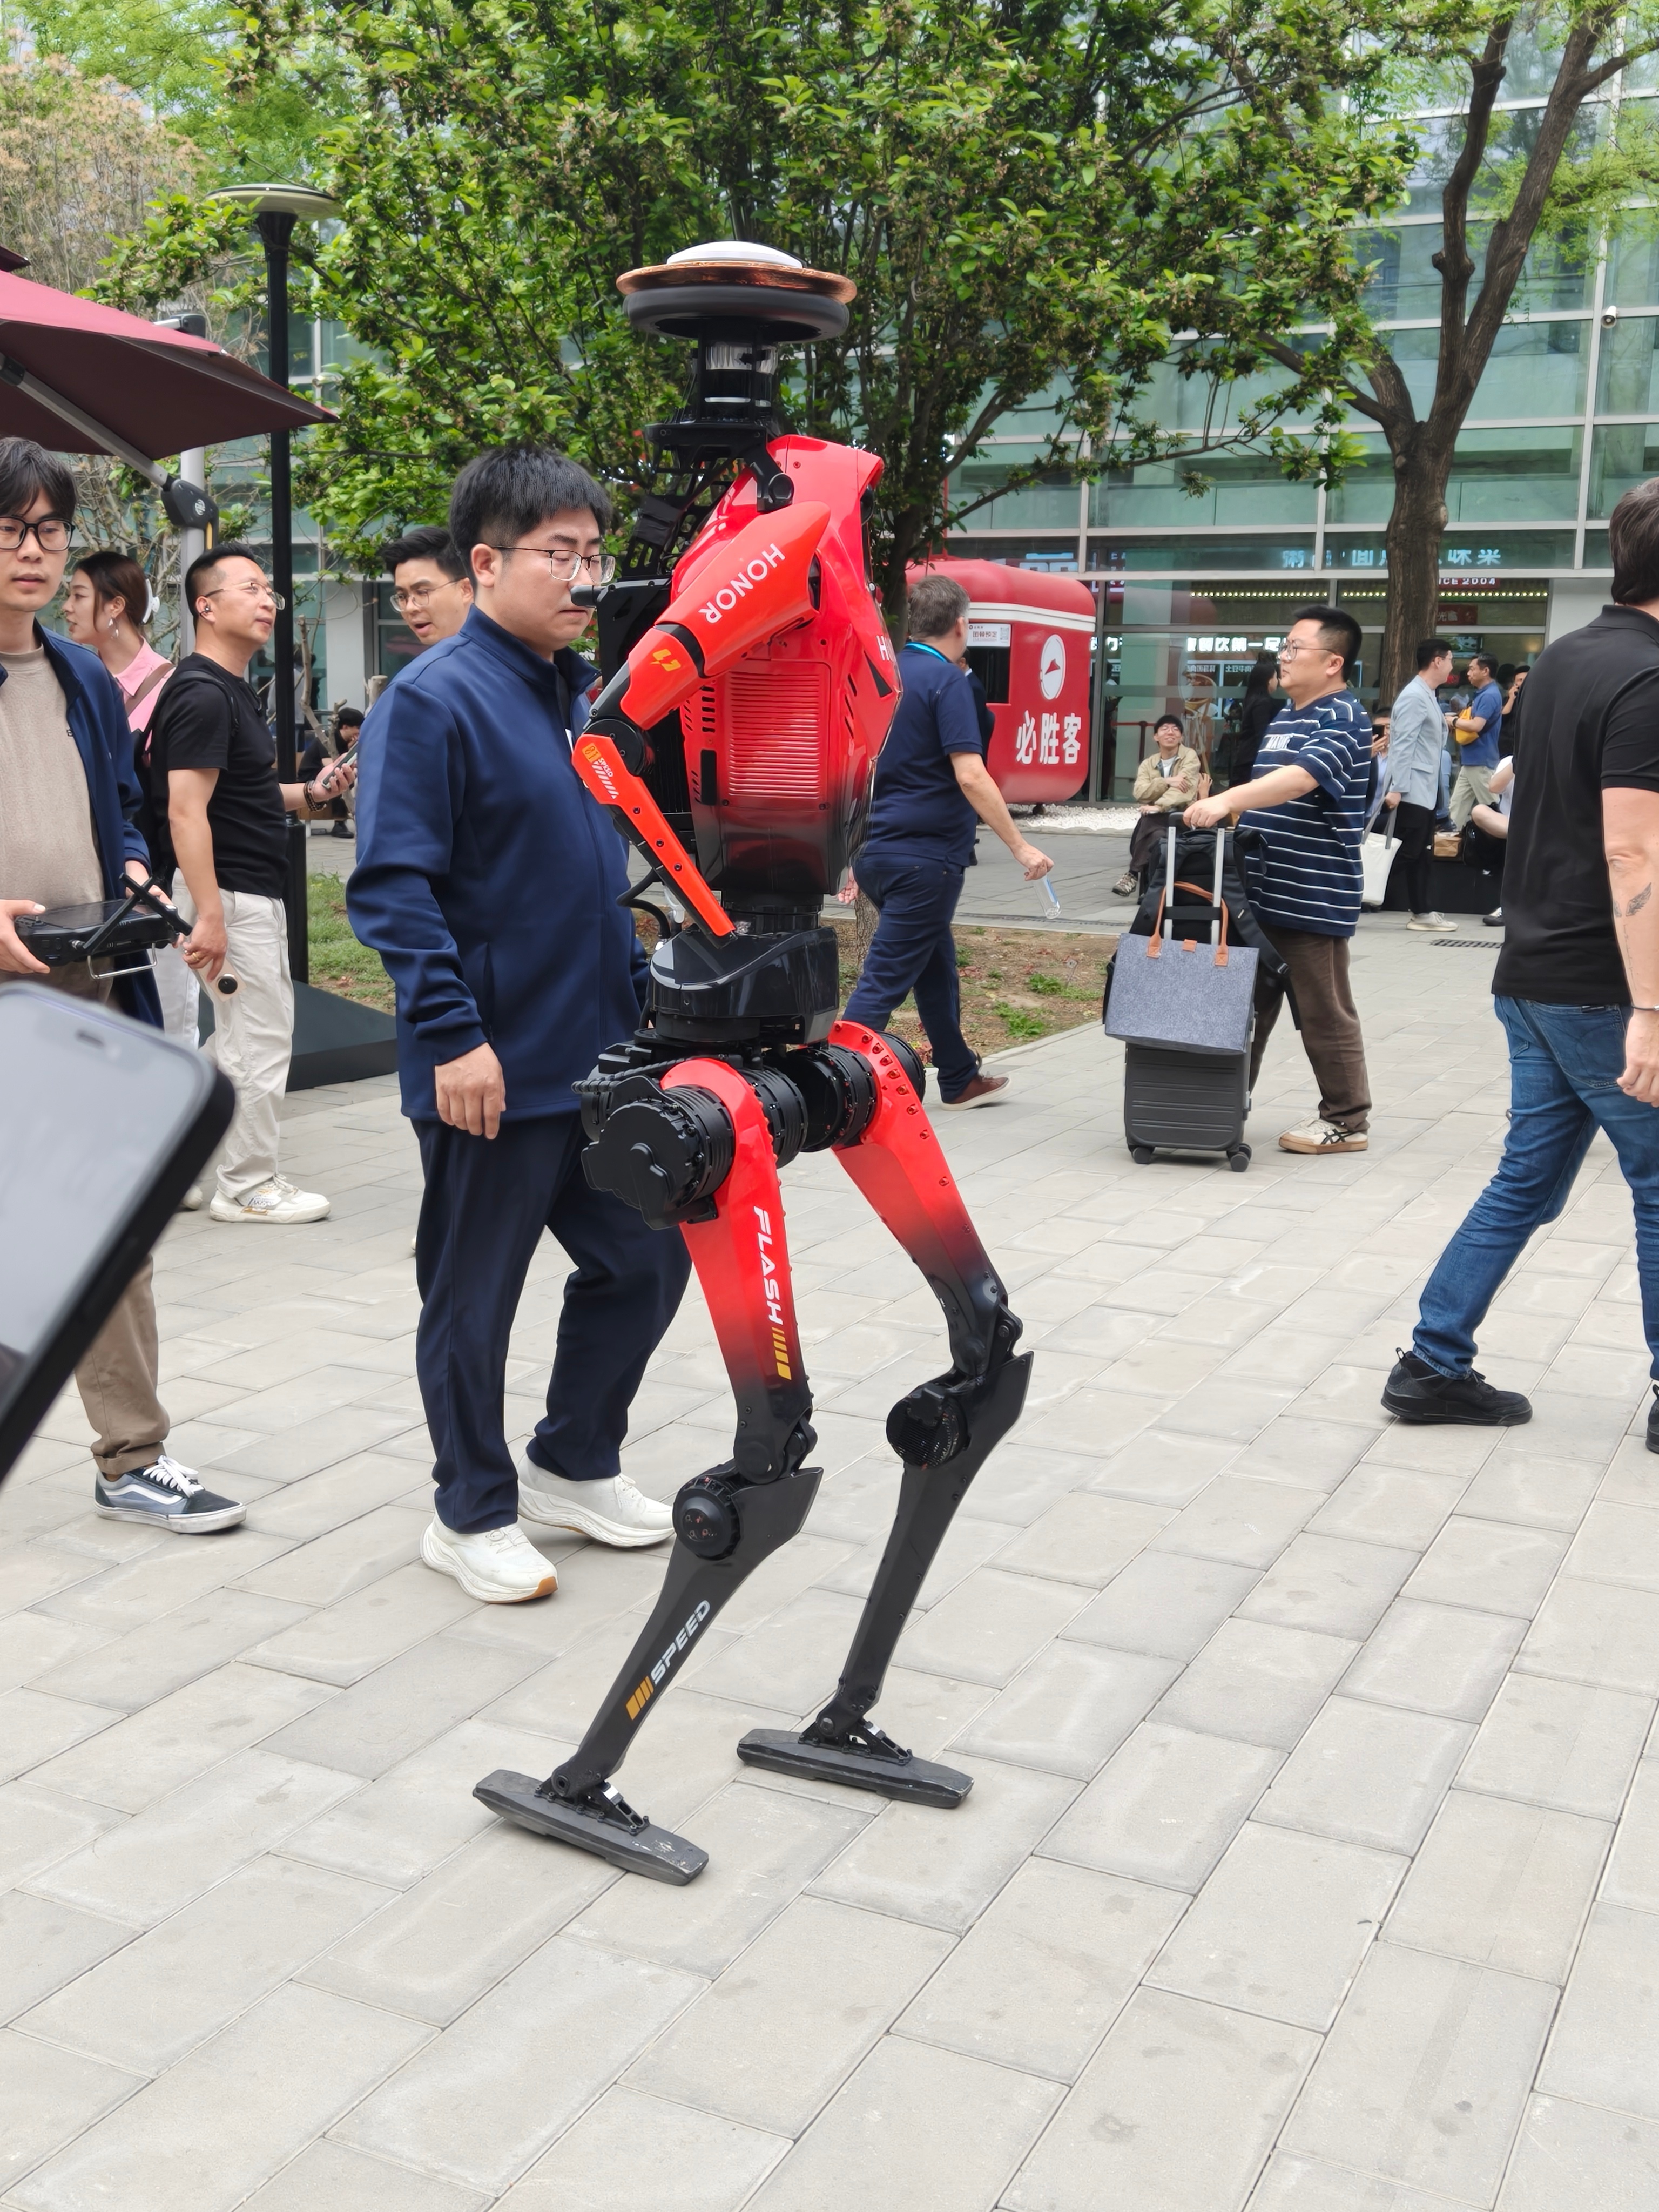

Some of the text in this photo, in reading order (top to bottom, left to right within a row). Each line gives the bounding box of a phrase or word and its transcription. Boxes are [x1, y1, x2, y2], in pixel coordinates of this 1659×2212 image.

[698, 543, 786, 624] HONOR
[1016, 709, 1082, 765] 必胜客
[753, 1205, 783, 1325] FLASH
[651, 1600, 711, 1685] SPEED
